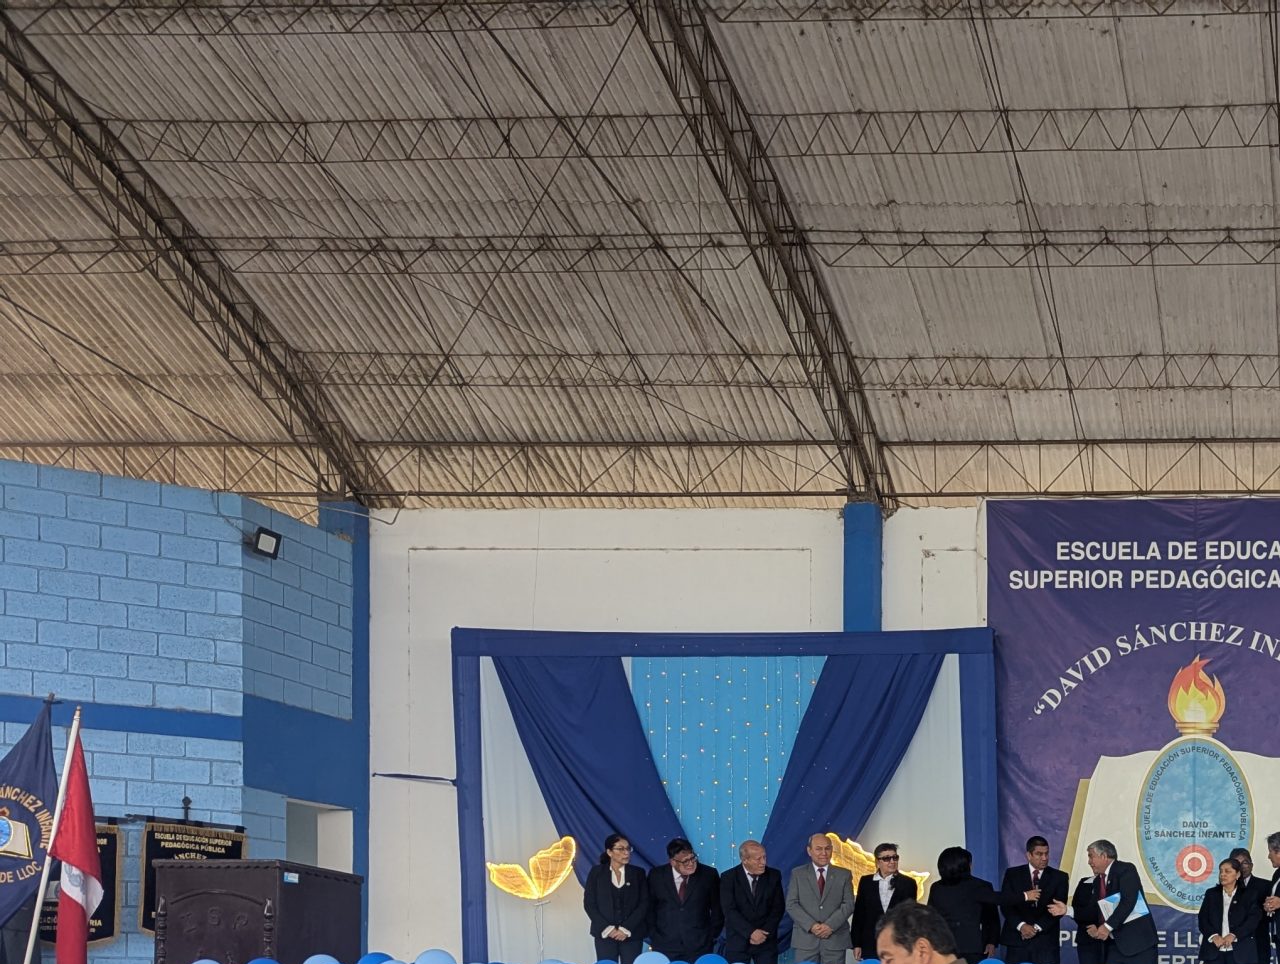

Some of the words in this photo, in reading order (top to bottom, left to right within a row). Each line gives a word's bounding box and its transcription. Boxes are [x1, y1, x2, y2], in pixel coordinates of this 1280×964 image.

[1056, 541, 1162, 561] ESCUELA
[1168, 541, 1198, 560] DE
[1009, 569, 1123, 590] SUPERIOR
[1116, 621, 1245, 657] SÁNCHEZ
[1180, 745, 1220, 760] SUPERIOR
[1149, 751, 1180, 791] EDUCACIÓN
[1219, 757, 1246, 807] PEDAGÓGICA
[0, 784, 43, 812] ÁNCHEZ
[1146, 792, 1154, 803] DE
[1144, 804, 1152, 841] ESCUELA
[1182, 821, 1209, 829] DAVID
[1198, 830, 1237, 839] INFANTE
[1238, 807, 1249, 841] PÚBLICA
[16, 861, 42, 881] LLOC
[1149, 856, 1160, 873] SAN
[1158, 872, 1177, 894] PEDRO
[1176, 891, 1187, 900] DE
